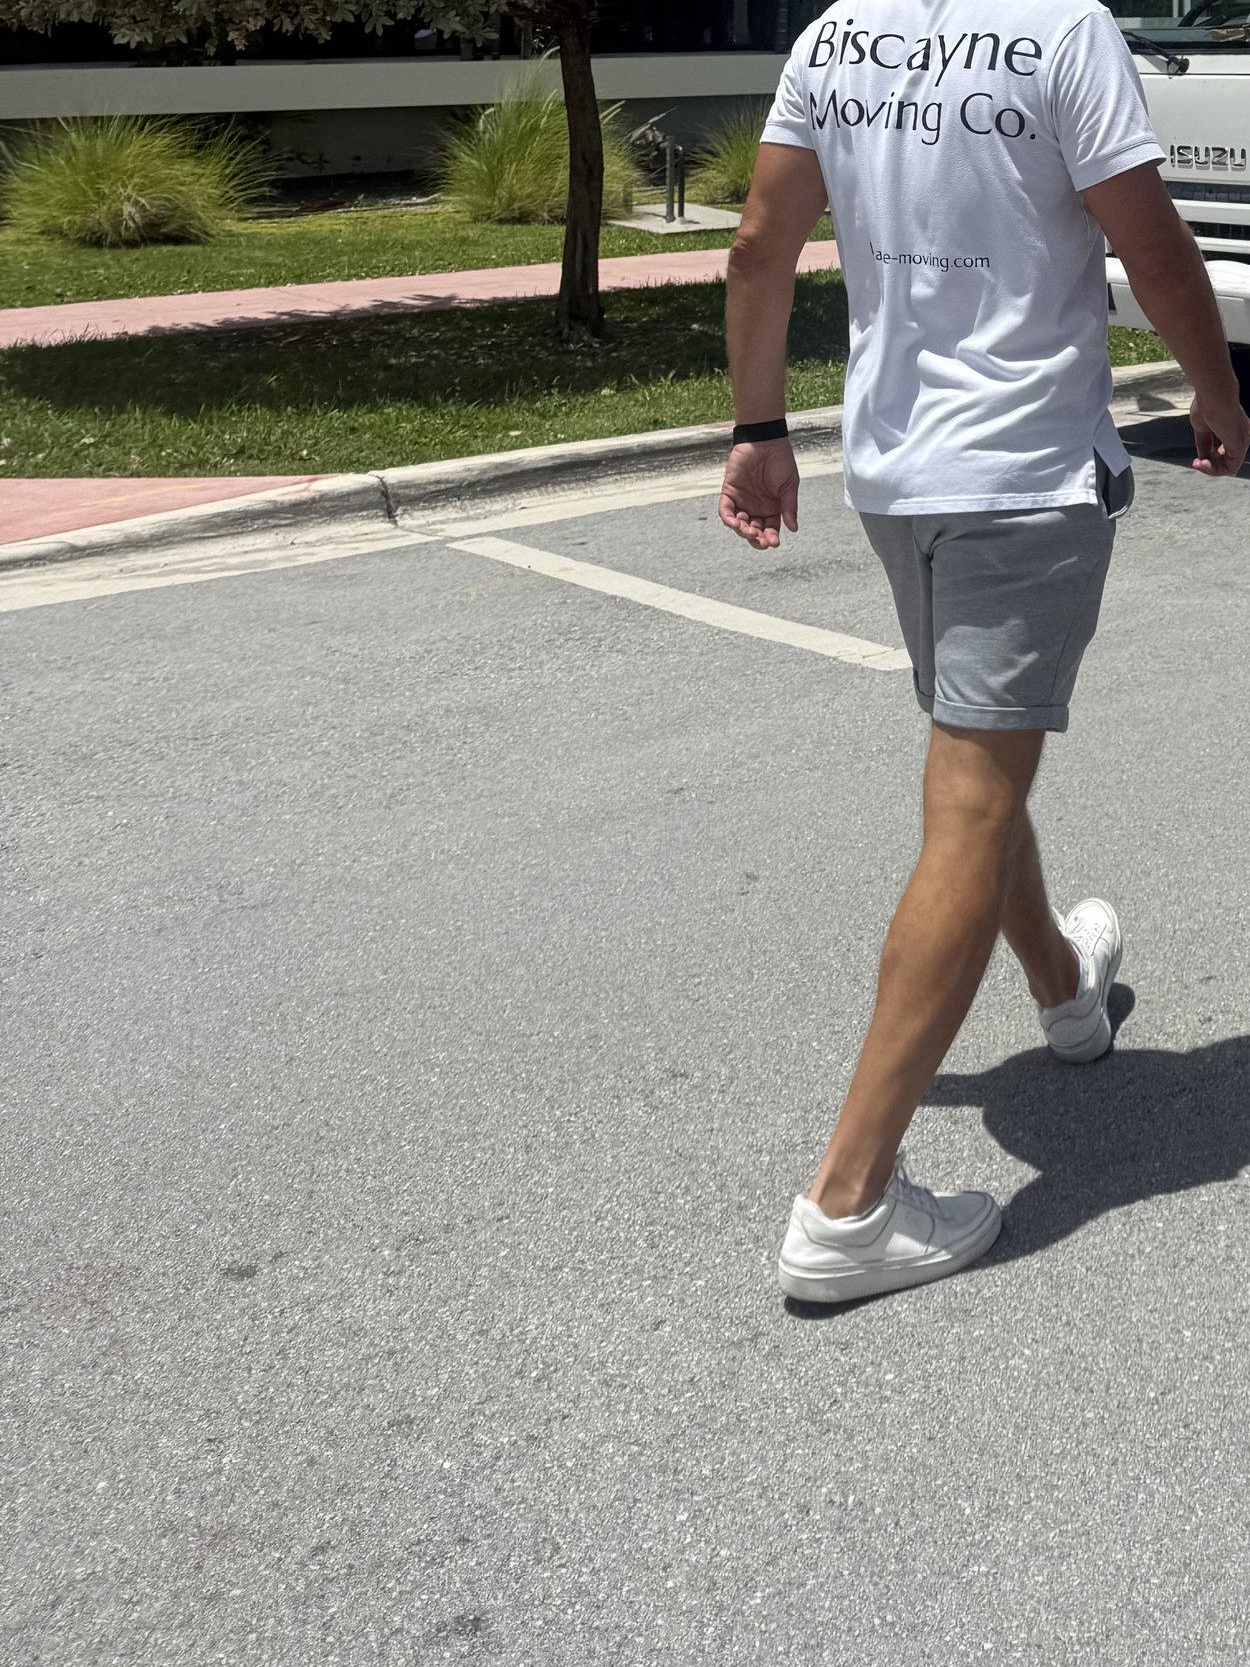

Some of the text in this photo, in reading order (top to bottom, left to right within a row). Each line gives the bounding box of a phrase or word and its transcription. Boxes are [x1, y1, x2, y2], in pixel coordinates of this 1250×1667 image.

[808, 18, 1043, 87] Biscayne
[809, 89, 1037, 146] Moving Co.
[1169, 144, 1247, 171] ISUZU
